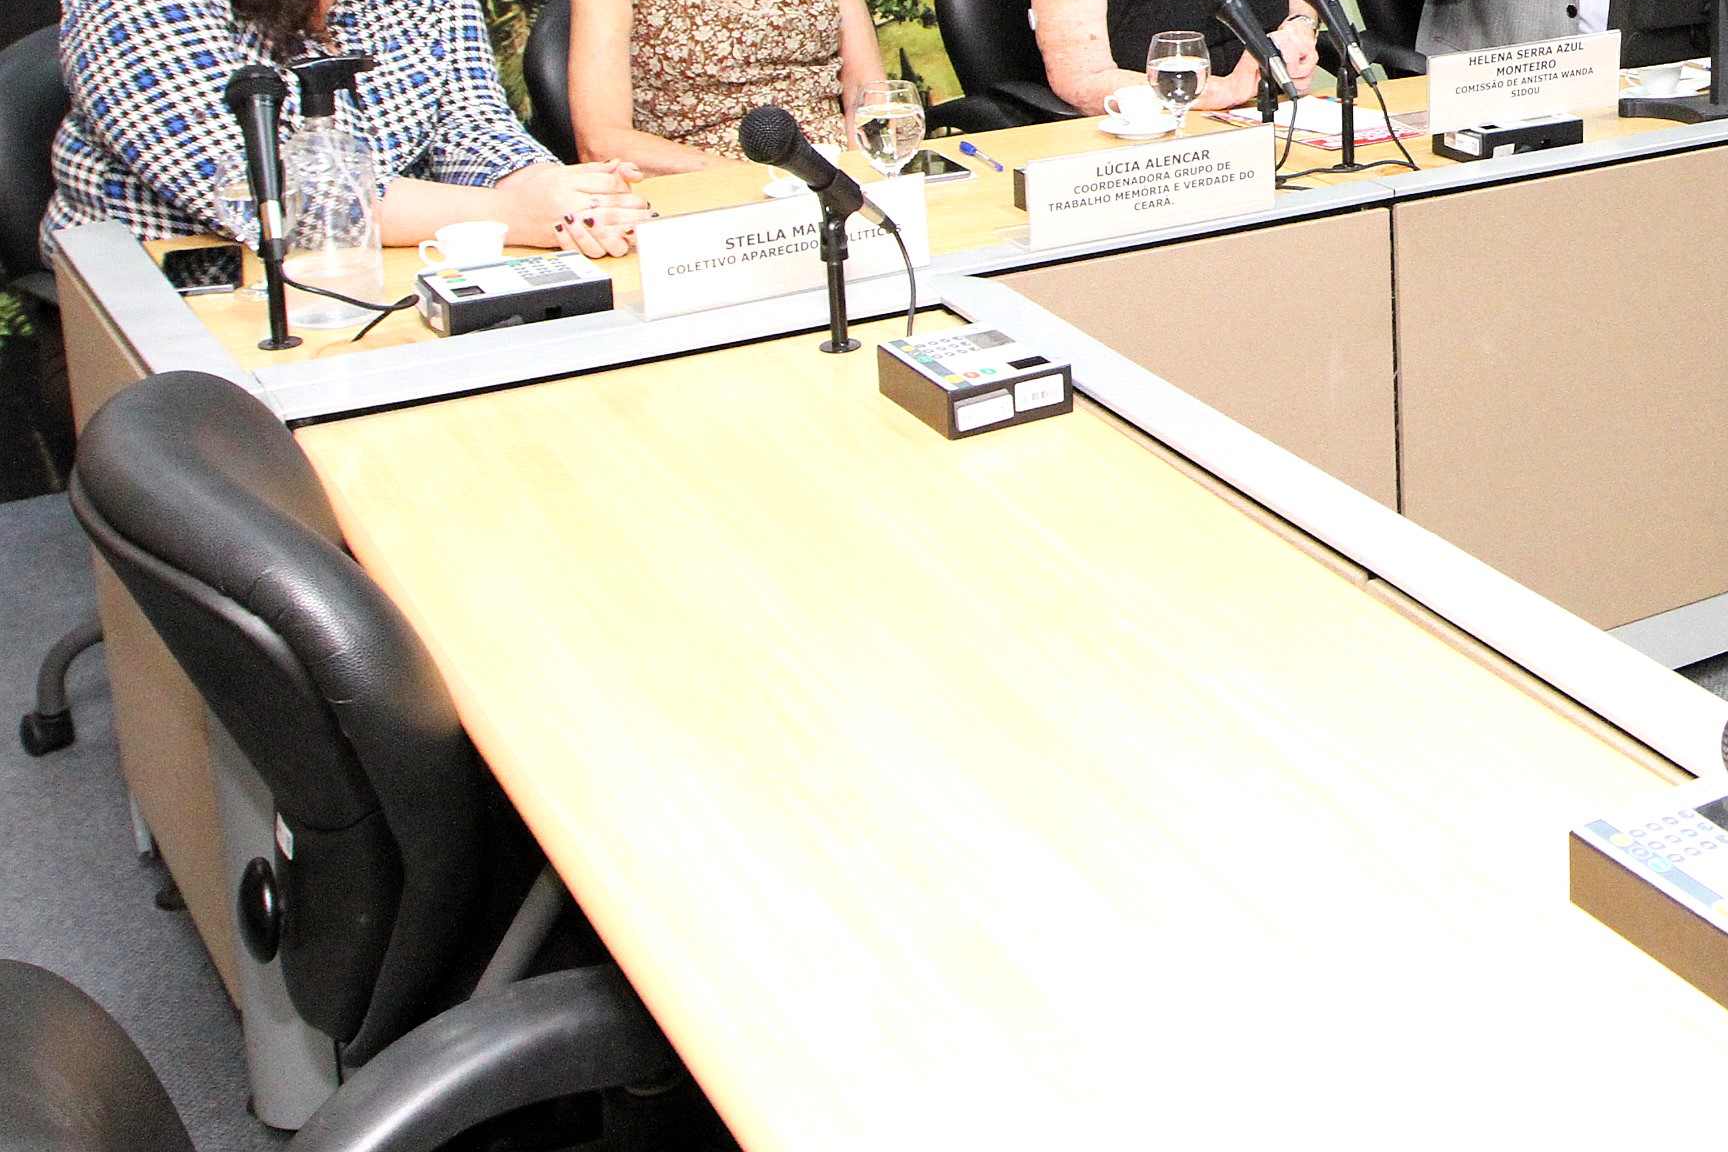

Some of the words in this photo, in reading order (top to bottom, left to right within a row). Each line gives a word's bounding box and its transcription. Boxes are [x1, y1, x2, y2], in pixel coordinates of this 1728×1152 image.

[1469, 51, 1513, 66] HELENA
[1516, 46, 1553, 59] SERRA
[1557, 42, 1584, 53] AZUL
[1455, 80, 1504, 94] COMISSÃO
[1507, 79, 1518, 87] DE
[1521, 73, 1558, 84] ANISTIA
[1561, 67, 1594, 78] WANDA
[1496, 60, 1557, 76] MONTEIRO
[1511, 87, 1540, 97] SIDOU
[1096, 161, 1140, 177] LÚCIA
[1145, 149, 1210, 169] ALENCAR
[1073, 171, 1170, 195] COORDENADORA
[1174, 164, 1213, 178] GRUPO
[1217, 161, 1231, 171] DE
[1048, 194, 1111, 212] TRABALHO
[1115, 184, 1170, 201] MEMÓRIA
[1174, 183, 1180, 191] E
[1184, 173, 1235, 190] VERDADE
[1239, 170, 1255, 180] DO
[1134, 195, 1174, 211] CEARÁ.
[725, 229, 786, 250] STELLA
[667, 255, 737, 276] COLETIVO
[741, 239, 820, 263] APARECIDO
